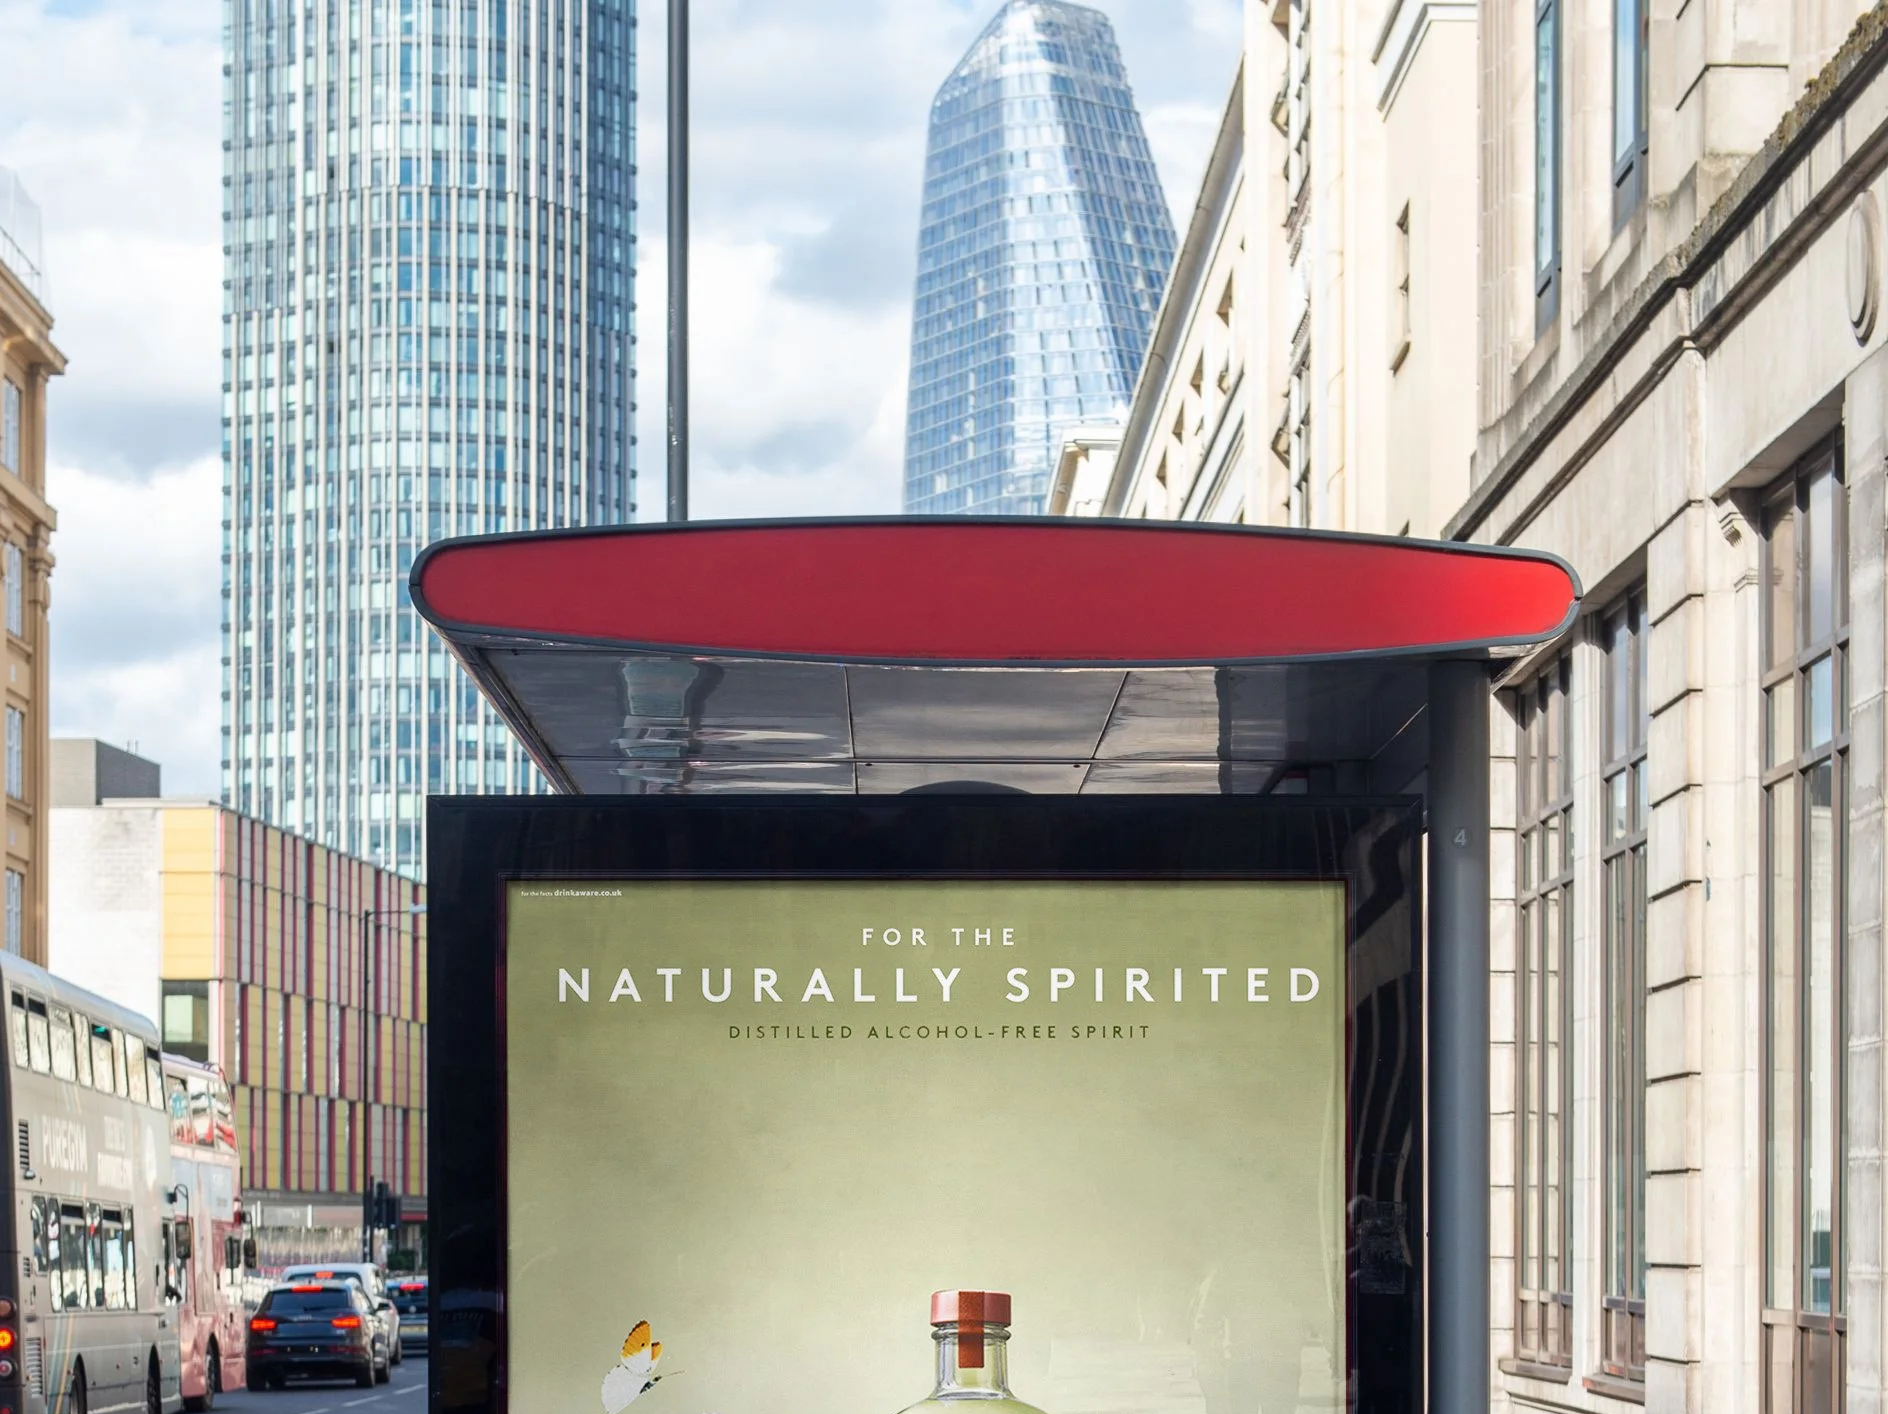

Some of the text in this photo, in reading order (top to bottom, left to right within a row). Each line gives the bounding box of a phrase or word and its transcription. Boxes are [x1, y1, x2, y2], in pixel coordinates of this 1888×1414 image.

[1454, 828, 1467, 846] 4
[554, 888, 622, 897] drinkaware.co.uk
[862, 928, 1016, 947] FOR THE
[558, 967, 1322, 1003] NATURALLY SPIRITED
[729, 1026, 1150, 1040] DISTILLED ALCOHOL-FREE SPIRIT
